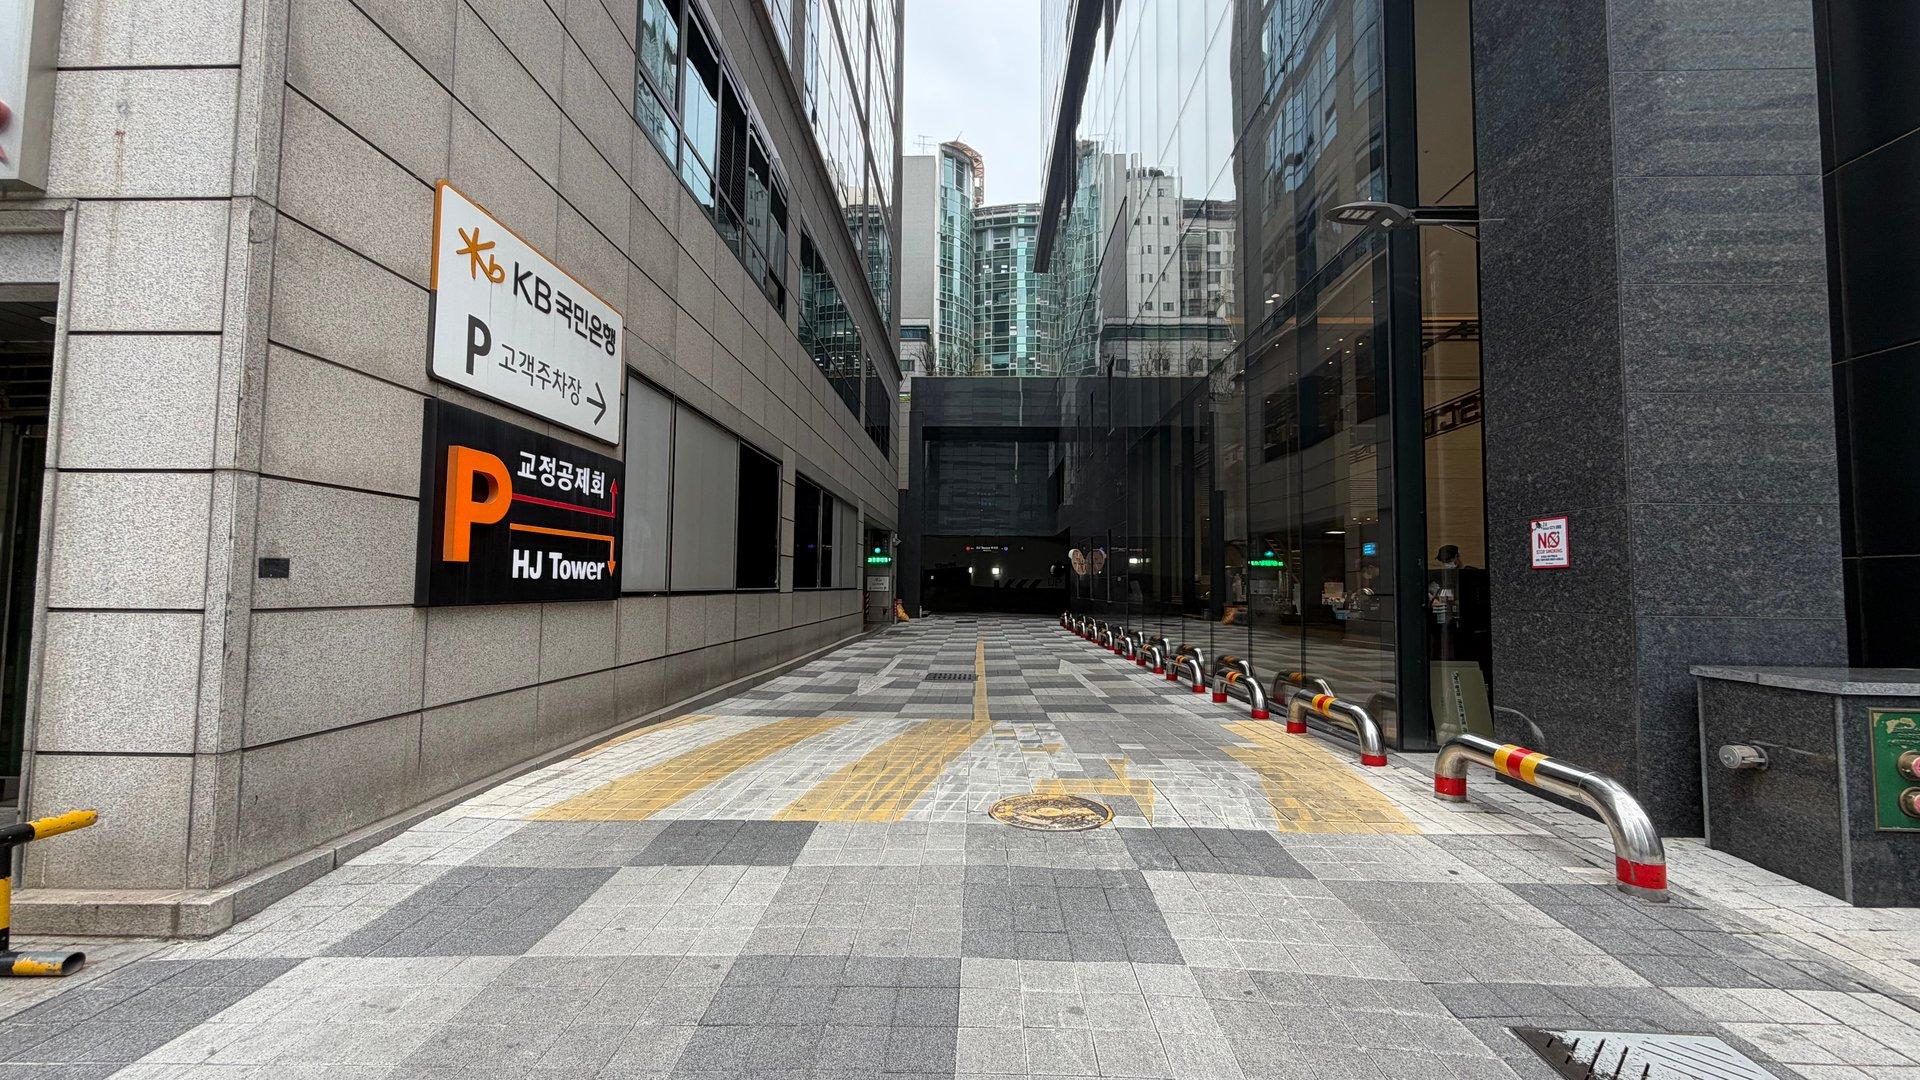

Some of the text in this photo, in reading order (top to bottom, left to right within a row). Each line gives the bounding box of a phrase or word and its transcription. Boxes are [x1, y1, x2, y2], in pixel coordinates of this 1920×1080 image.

[513, 262, 616, 356] KB국민은행
[466, 314, 582, 406] P 고객주차장
[443, 445, 513, 562] P
[517, 450, 605, 499] 교정공제회
[512, 549, 605, 580] HJ Tower
